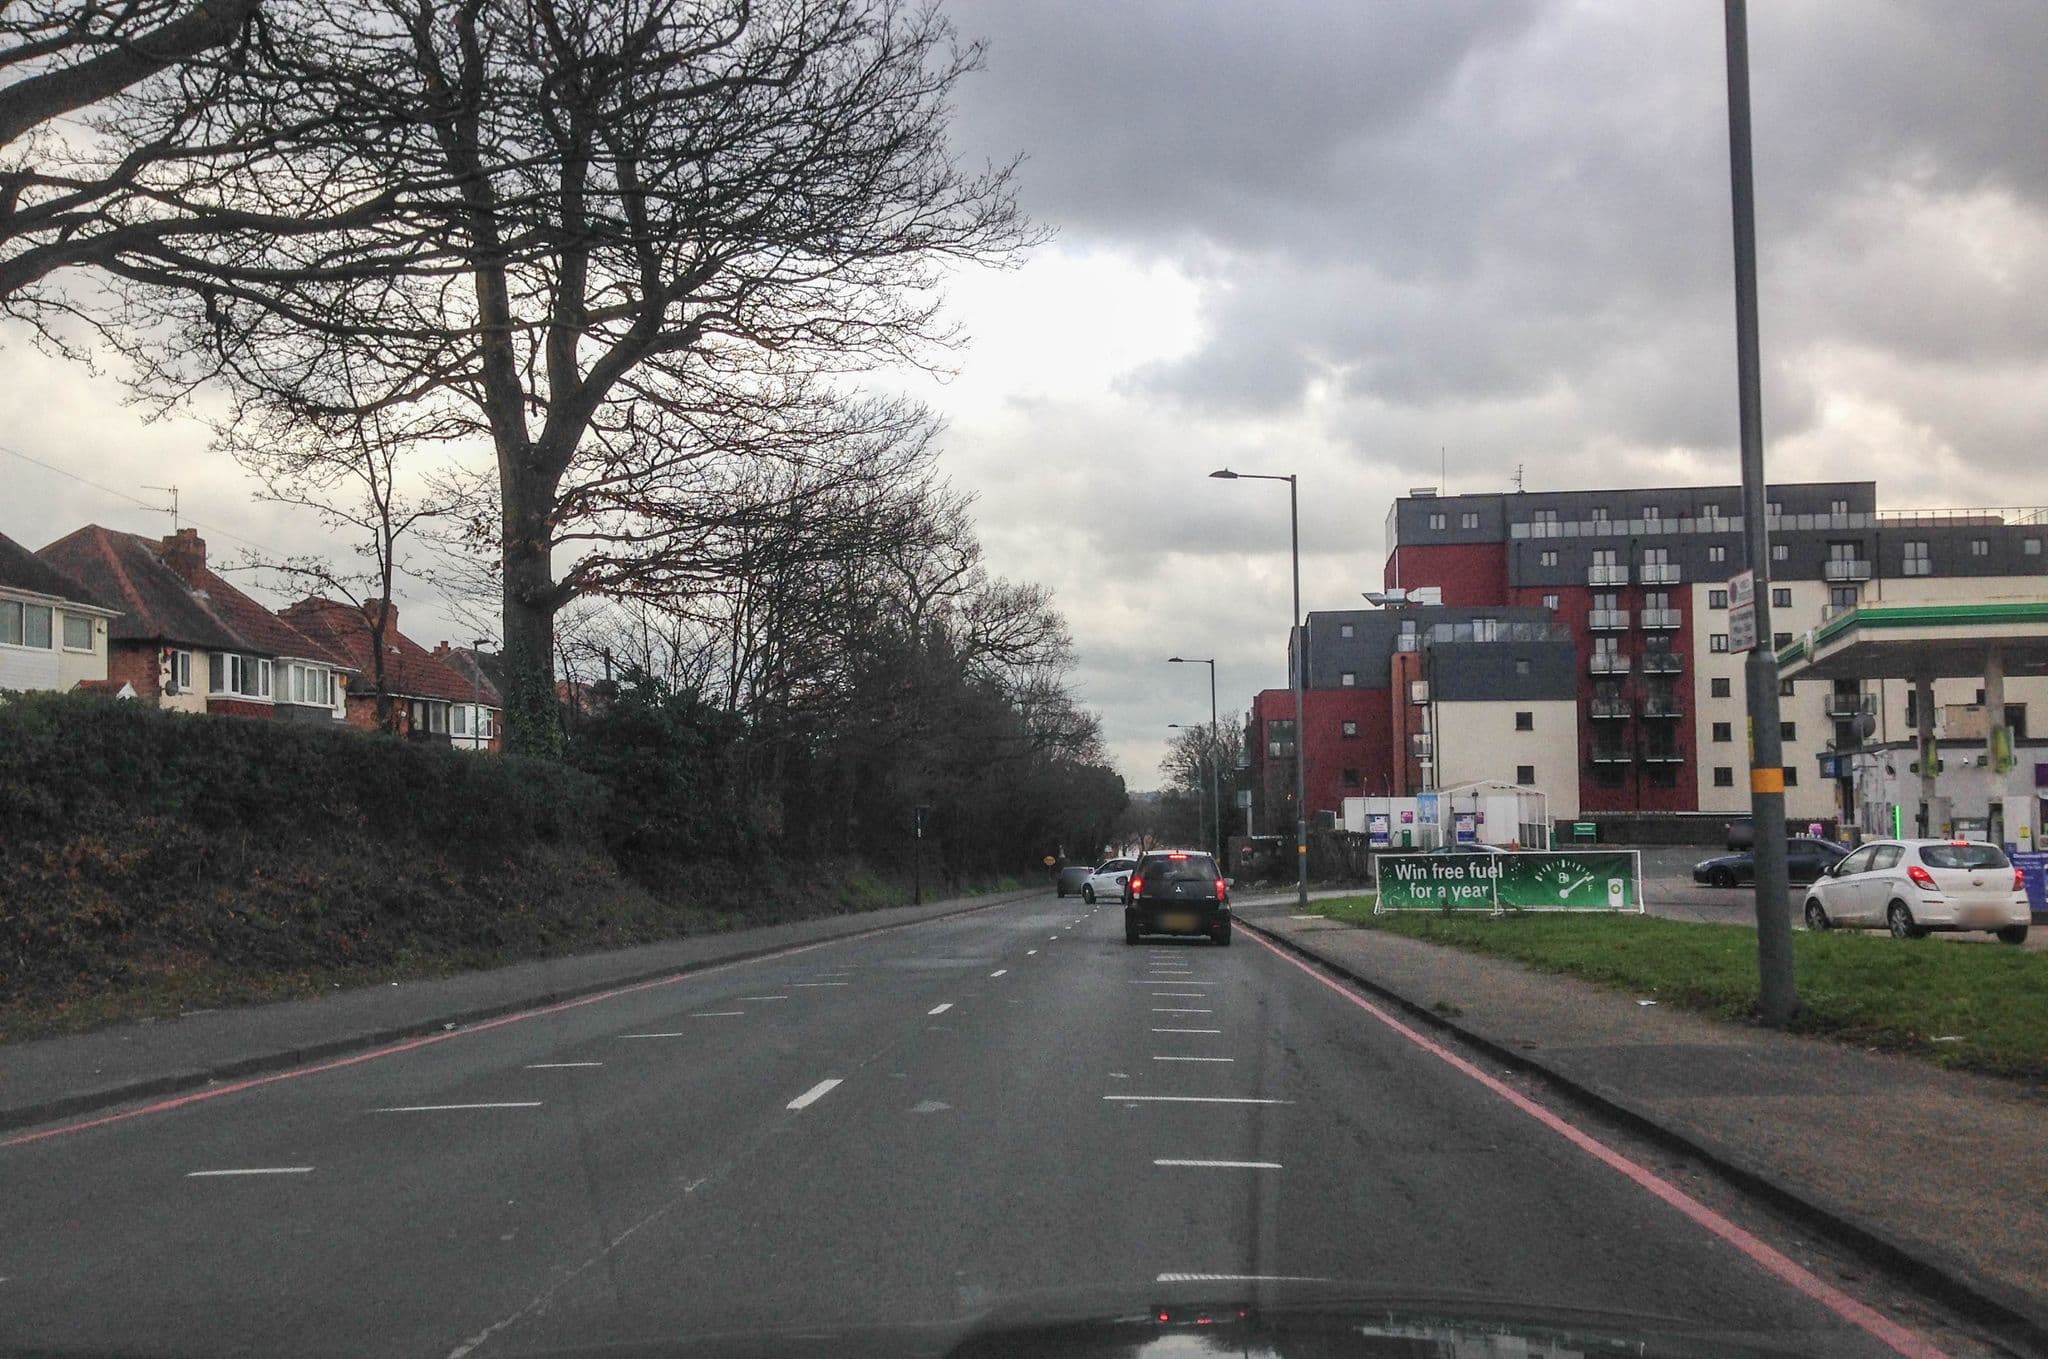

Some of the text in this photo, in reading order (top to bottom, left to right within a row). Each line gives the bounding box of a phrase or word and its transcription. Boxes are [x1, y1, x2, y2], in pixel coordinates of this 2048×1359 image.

[1395, 862, 1503, 880] Win free fuel
[1409, 882, 1489, 902] for a year
